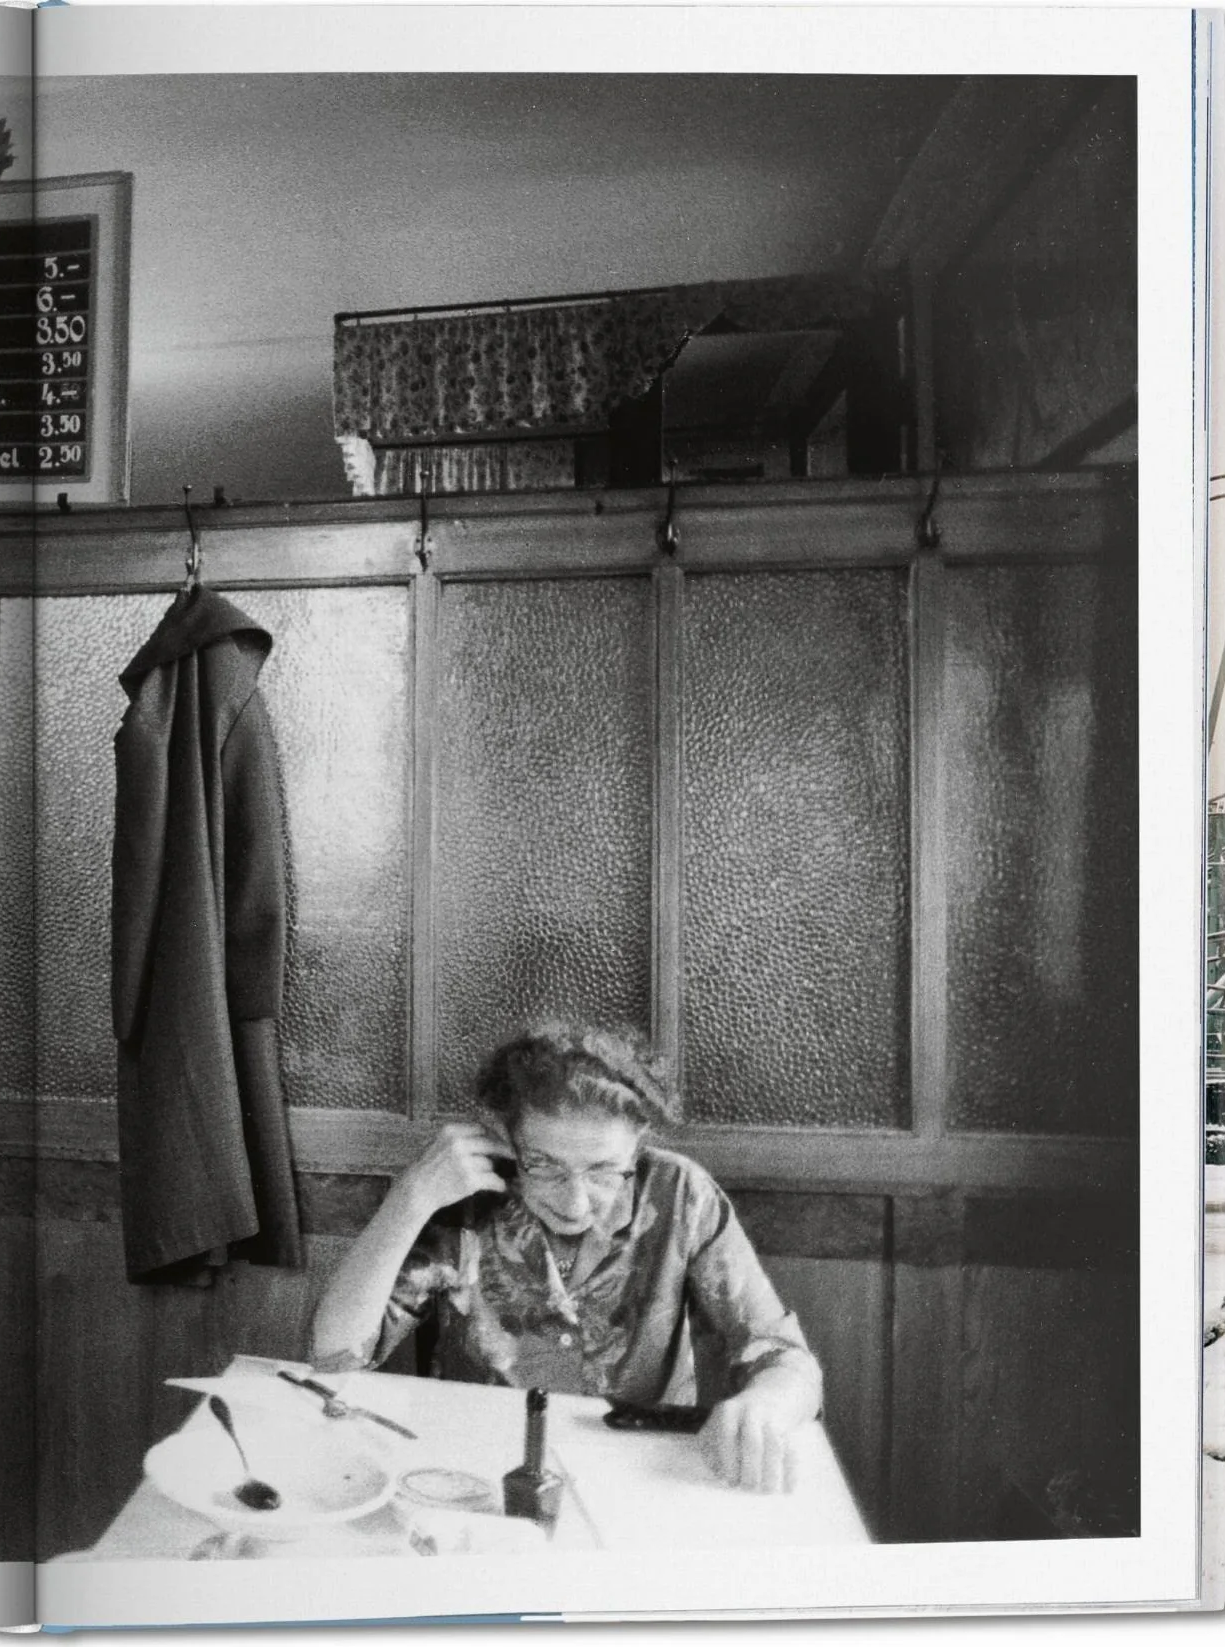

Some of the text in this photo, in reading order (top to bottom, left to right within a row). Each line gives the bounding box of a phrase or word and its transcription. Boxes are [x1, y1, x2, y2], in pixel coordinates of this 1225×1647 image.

[42, 352, 81, 375] 3.50
[40, 414, 81, 437] 3.50
[38, 444, 82, 469] 2.50
